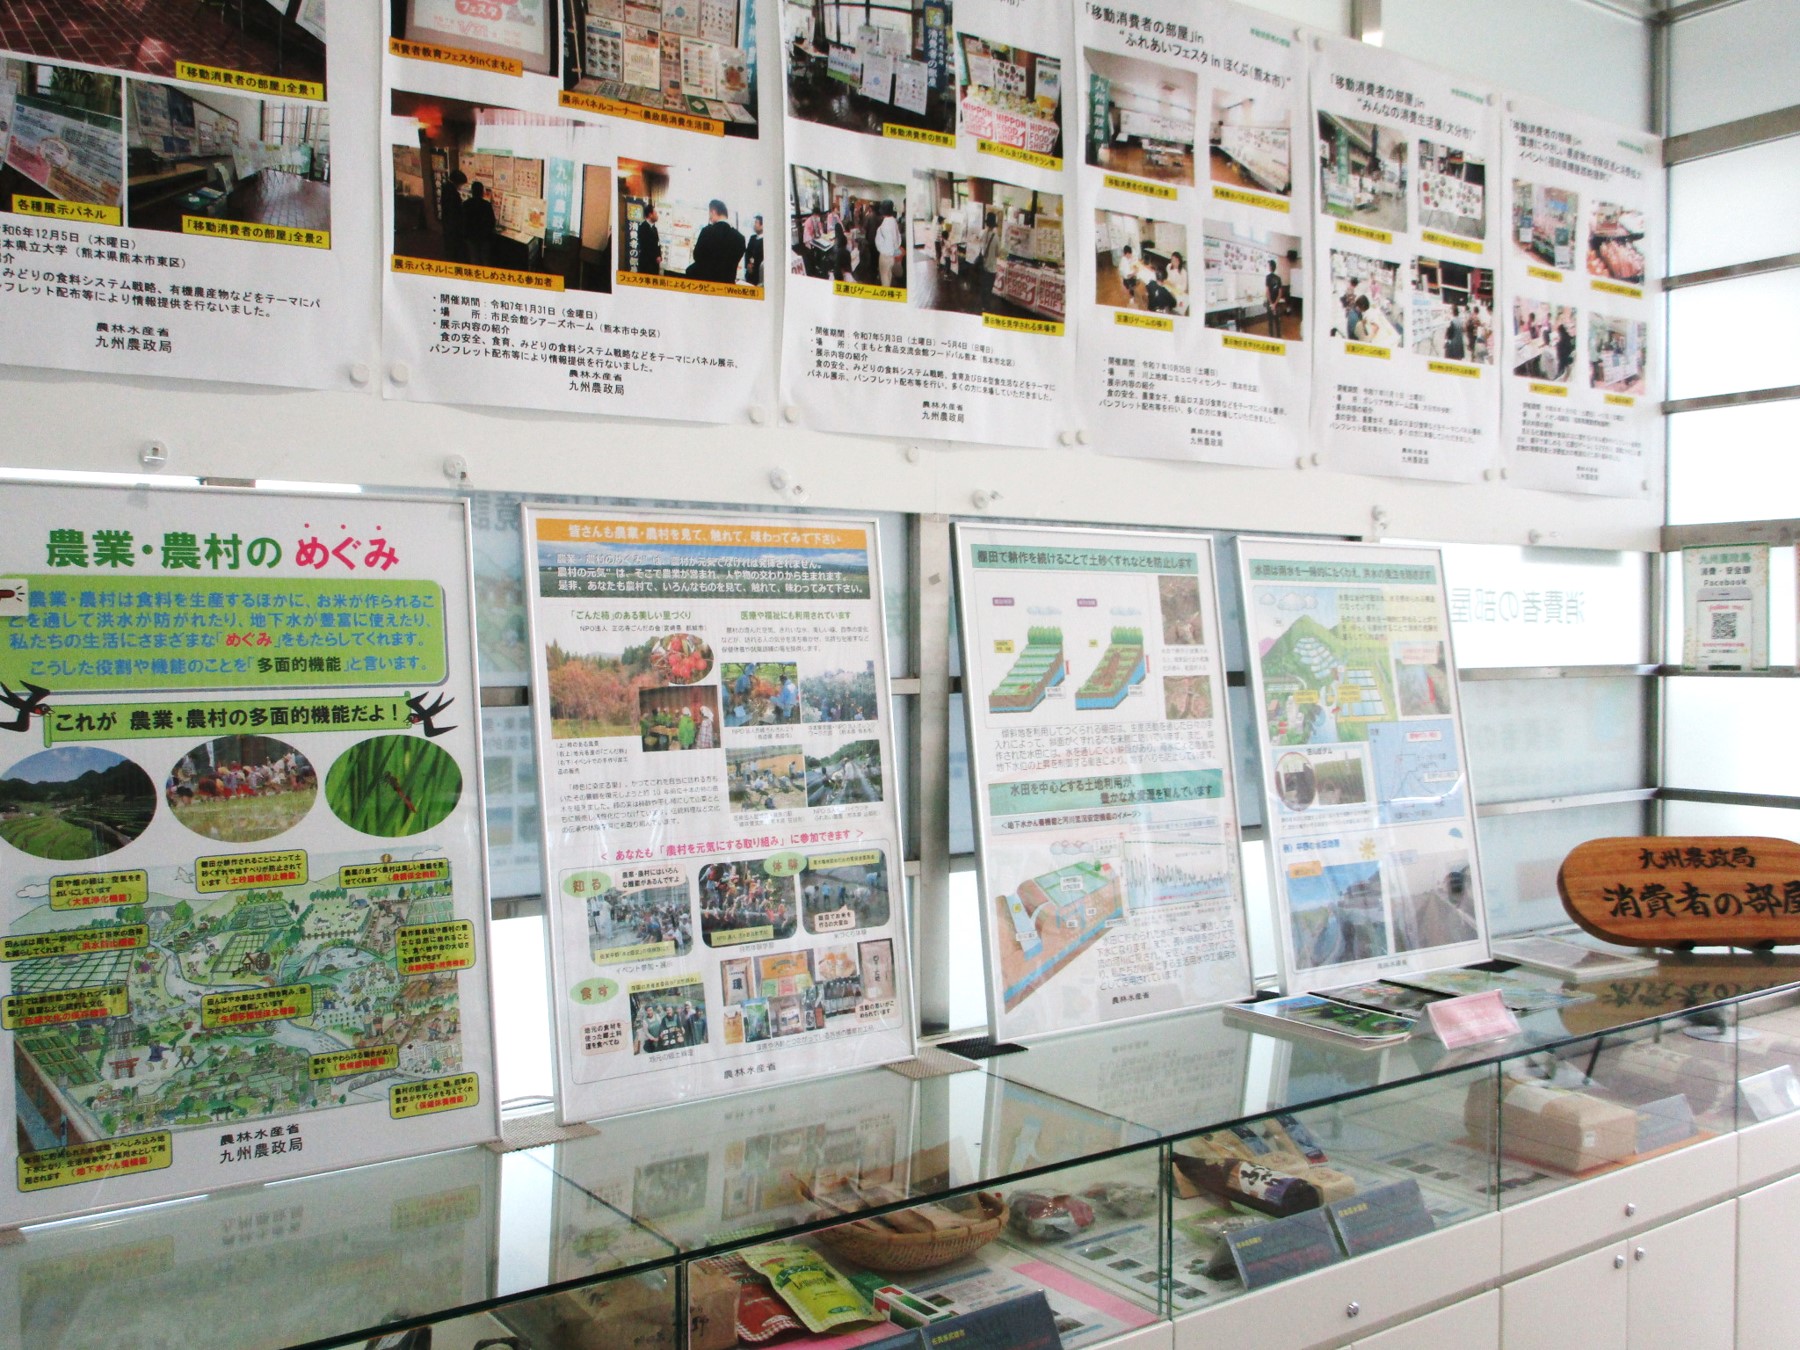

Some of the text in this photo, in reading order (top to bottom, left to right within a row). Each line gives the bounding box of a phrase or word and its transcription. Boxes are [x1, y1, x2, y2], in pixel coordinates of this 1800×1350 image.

[17, 198, 108, 220] 各種展示パネル
[186, 217, 324, 245] 「移動消費者の部屋」全景2
[0, 239, 187, 269] 本県立大学（熊本県熊本市東区）
[0, 281, 273, 318] フレット配布等により情報提供を行ないました。
[95, 321, 170, 337] 農林水産省
[95, 336, 173, 354] 九州農政局
[569, 369, 623, 382] 農林水産省
[568, 381, 625, 396] 九州農政局
[922, 411, 965, 423] 九州農政局
[46, 528, 400, 572] 農業・農村の めぐみ
[55, 711, 118, 731] これが
[219, 1123, 301, 1146] 農林水産省
[219, 1136, 304, 1165] 九州農政局
